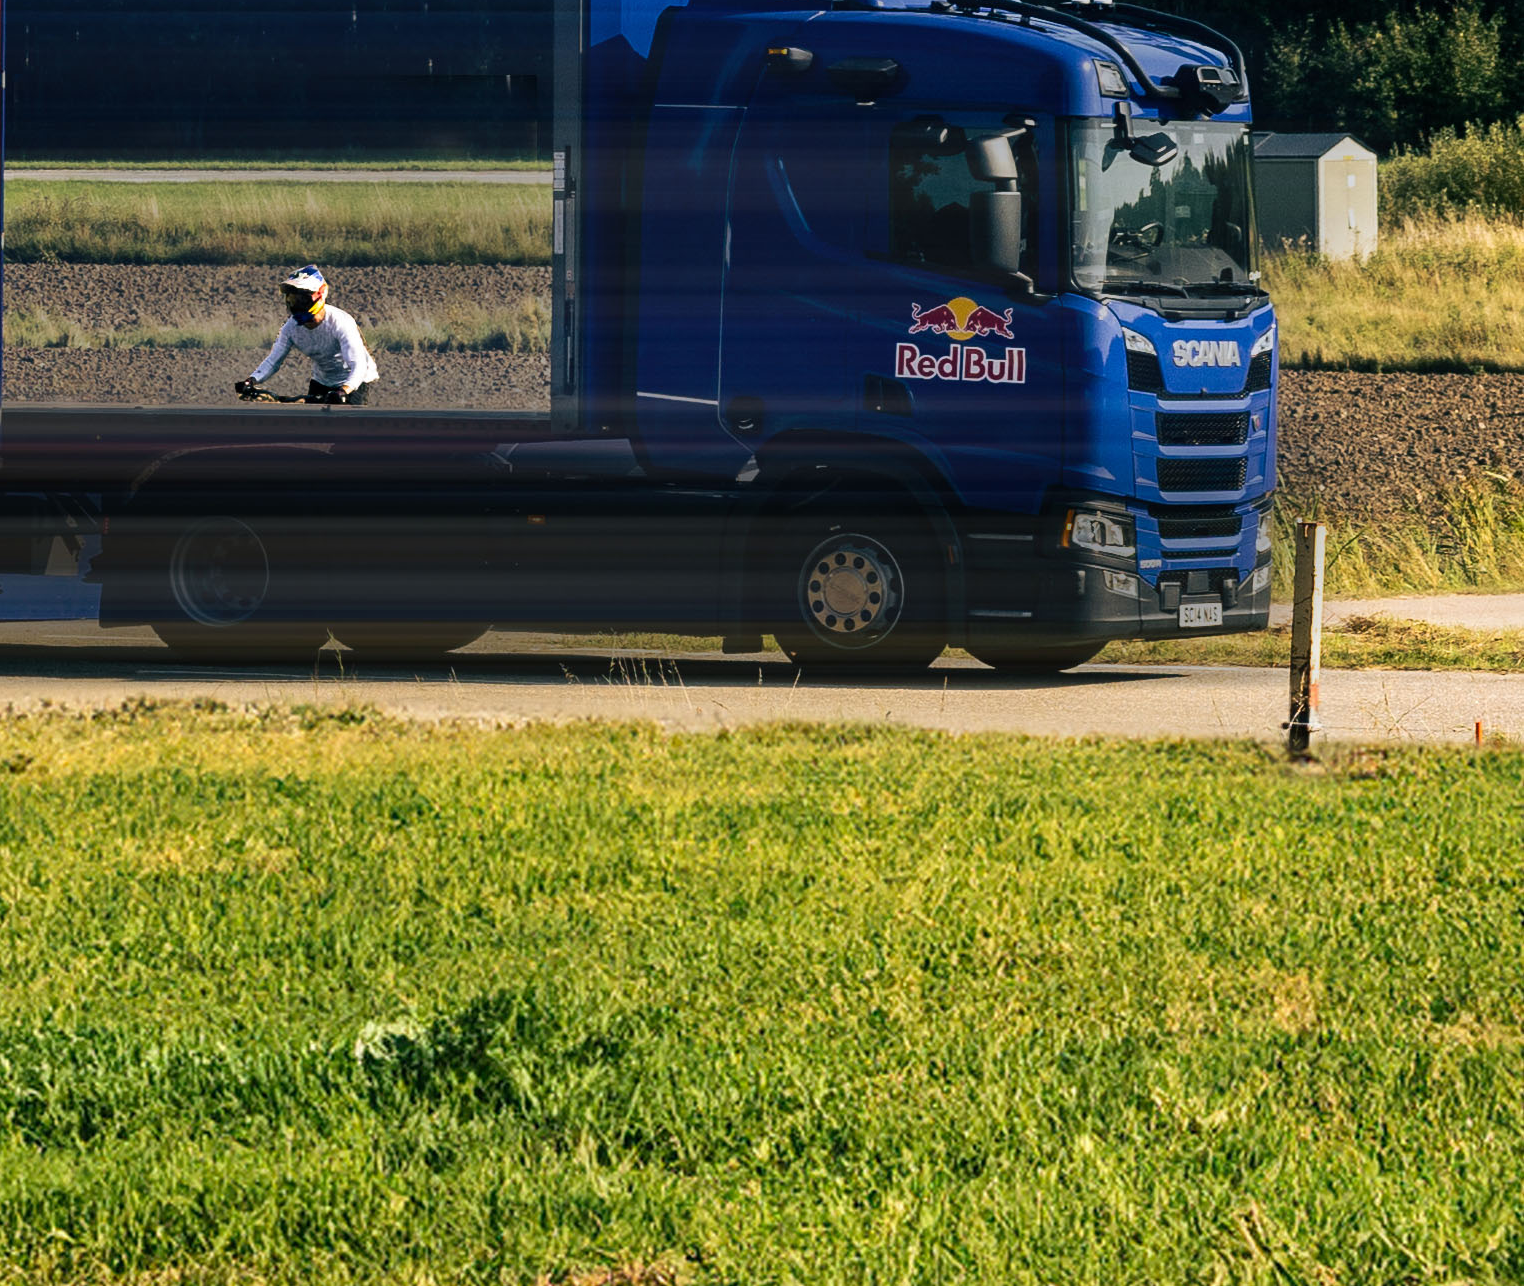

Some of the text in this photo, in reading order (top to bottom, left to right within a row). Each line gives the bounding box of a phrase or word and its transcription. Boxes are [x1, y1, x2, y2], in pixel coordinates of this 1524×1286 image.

[895, 343, 1026, 384] Red Bull
[1172, 339, 1241, 367] SCANIA
